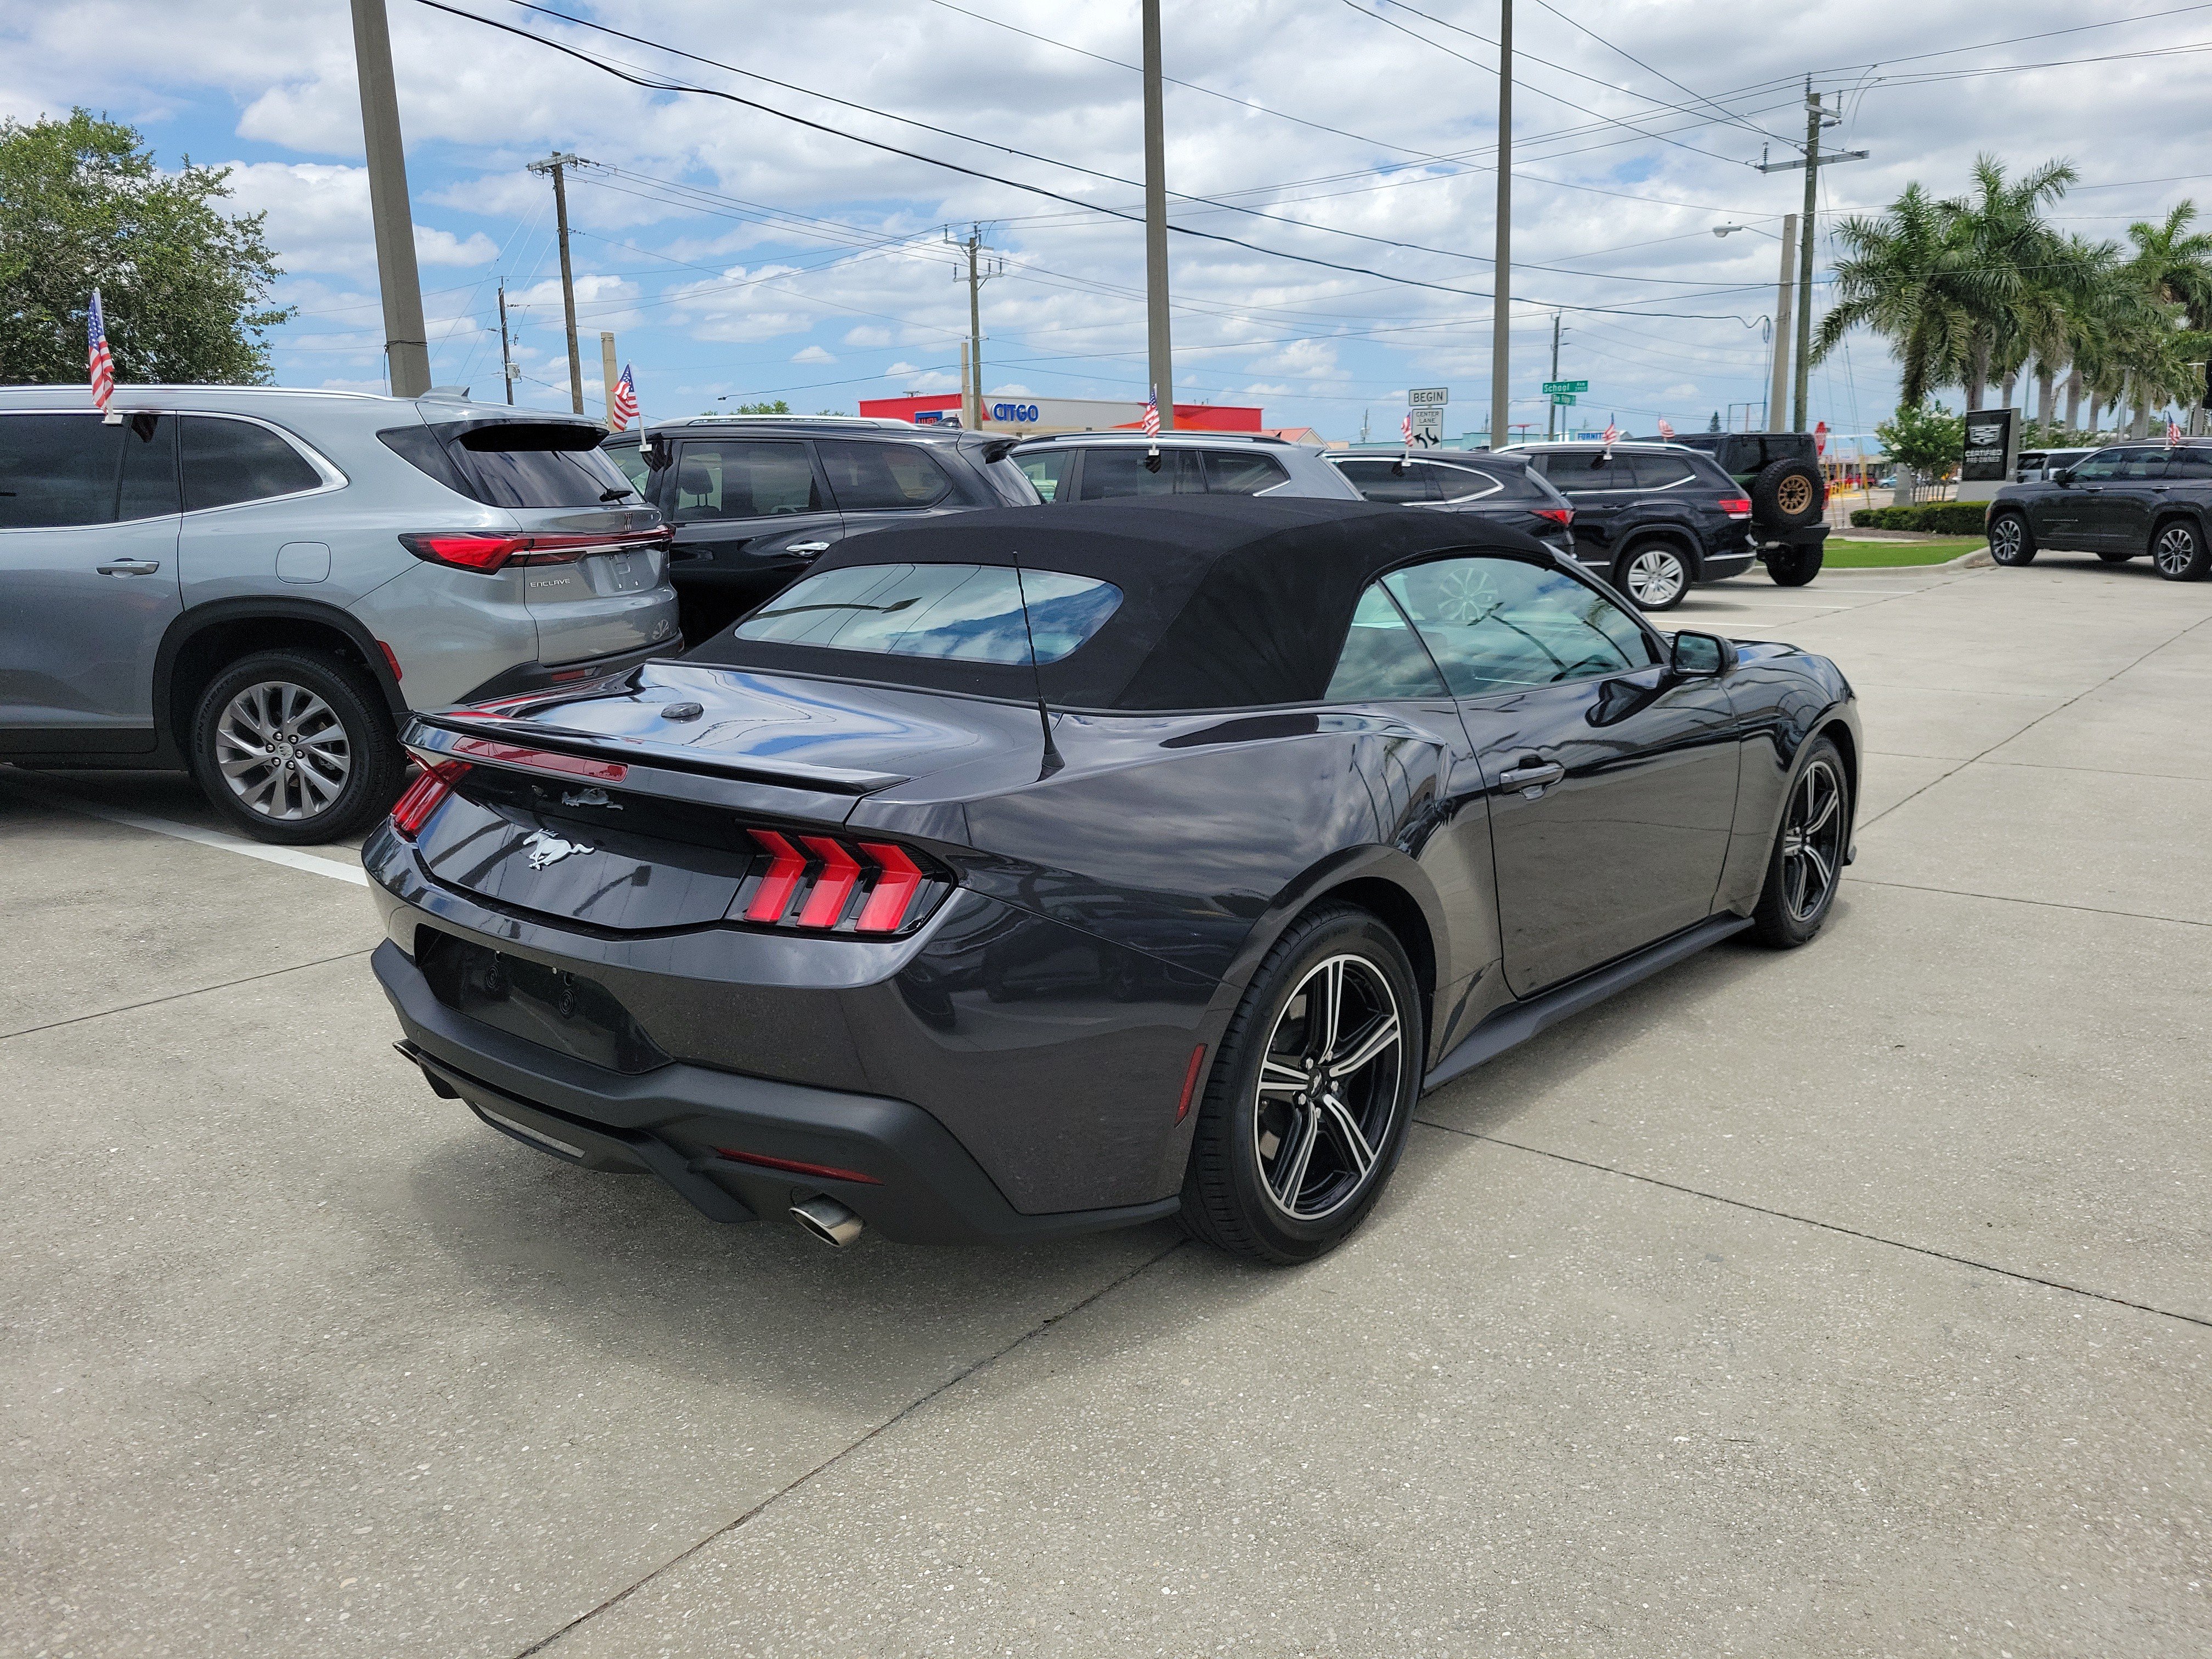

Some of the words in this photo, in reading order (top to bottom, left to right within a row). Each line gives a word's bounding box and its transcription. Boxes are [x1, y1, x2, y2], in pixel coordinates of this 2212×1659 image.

[1544, 383, 1570, 392] School
[1413, 391, 1443, 403] BEGIN
[993, 403, 1040, 422] CITGO
[530, 578, 571, 588] ENCLAVE
